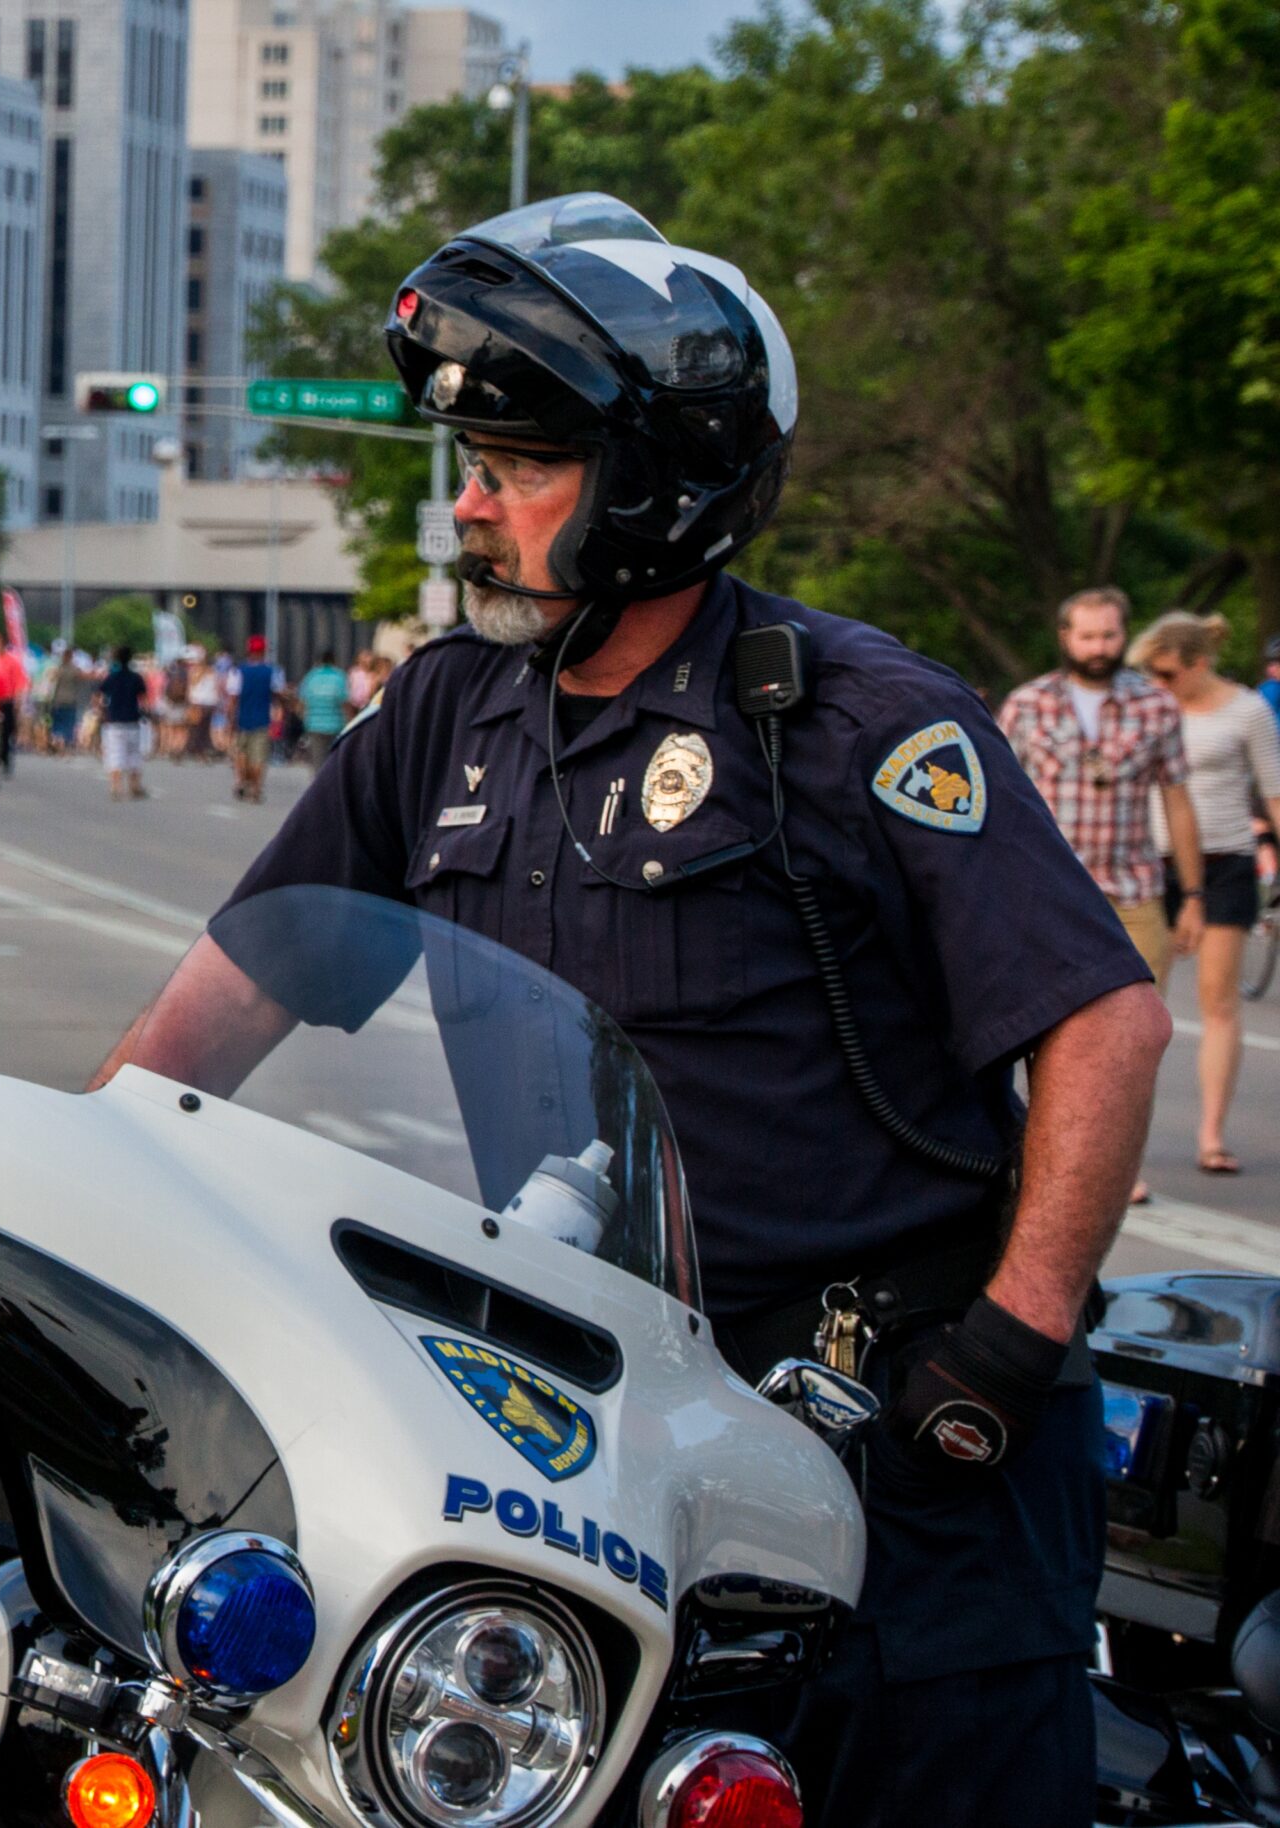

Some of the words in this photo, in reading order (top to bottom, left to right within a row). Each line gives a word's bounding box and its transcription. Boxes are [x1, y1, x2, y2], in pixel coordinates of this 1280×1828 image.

[877, 724, 959, 789] MADISON
[895, 797, 953, 827] POLICE
[435, 1341, 579, 1415] MADISON
[448, 1368, 525, 1447] POLICE
[548, 1419, 590, 1473] DEPARTMENT
[443, 1474, 669, 1613] POLICE
